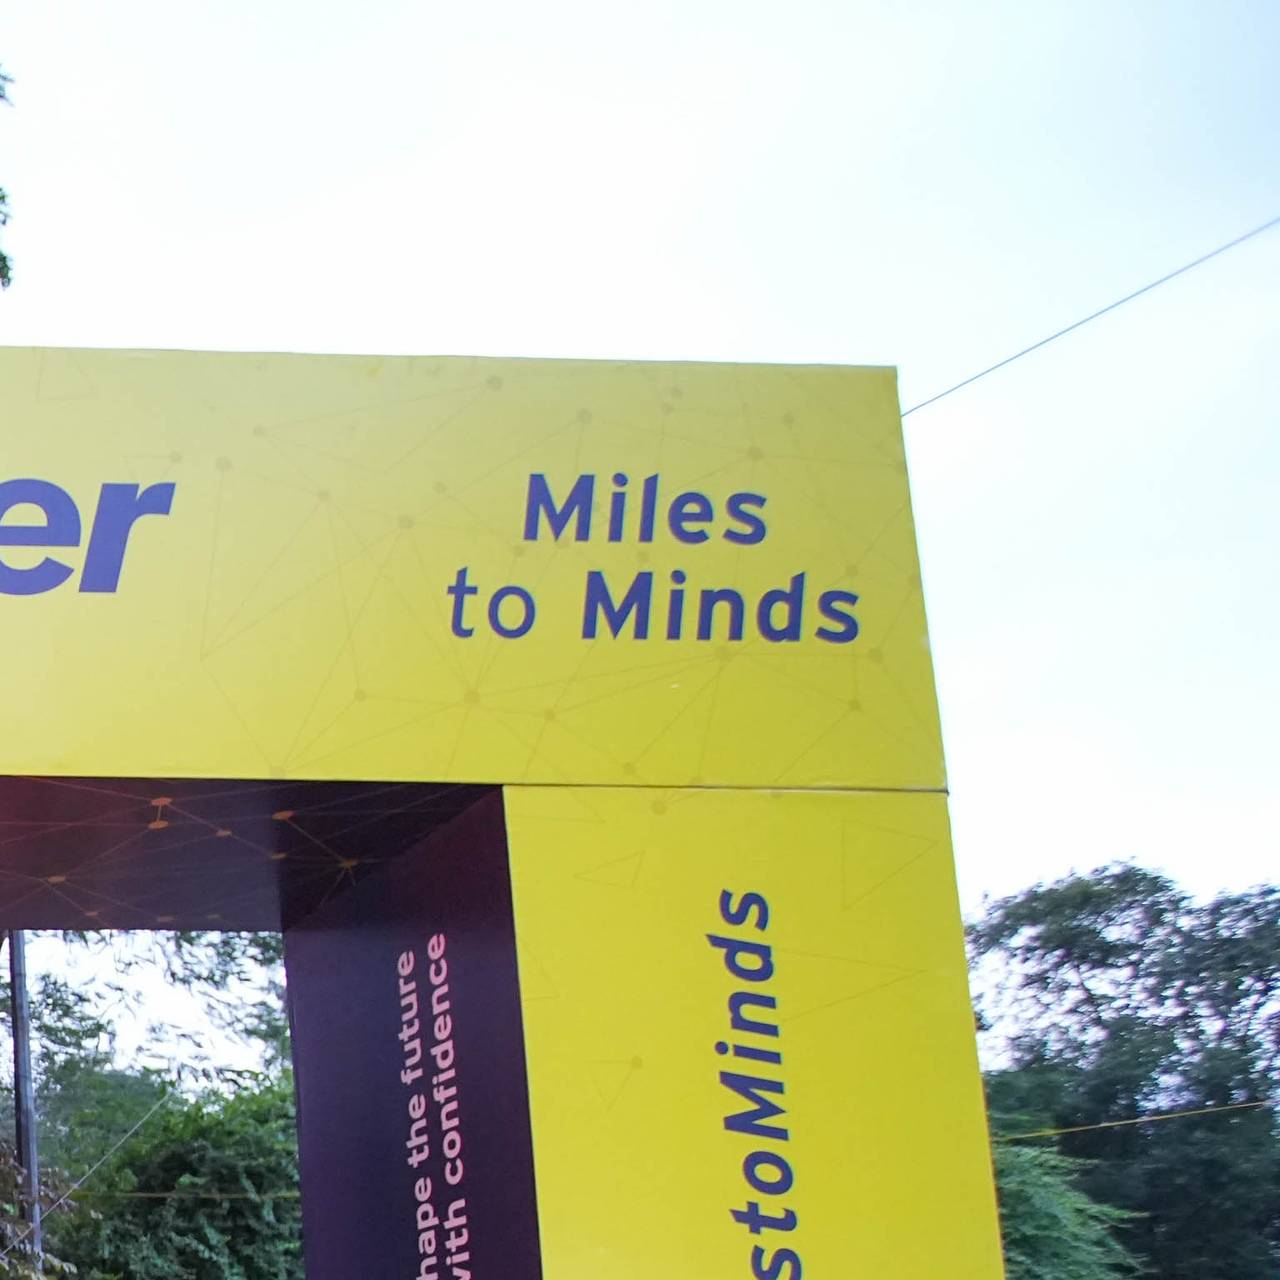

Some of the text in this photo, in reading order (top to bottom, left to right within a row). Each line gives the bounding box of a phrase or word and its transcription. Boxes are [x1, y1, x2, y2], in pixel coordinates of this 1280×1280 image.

[523, 472, 767, 545] Miles
[446, 566, 859, 644] to Minds
[396, 949, 425, 1083] future
[427, 933, 464, 1190] confidence
[406, 1093, 426, 1168] the
